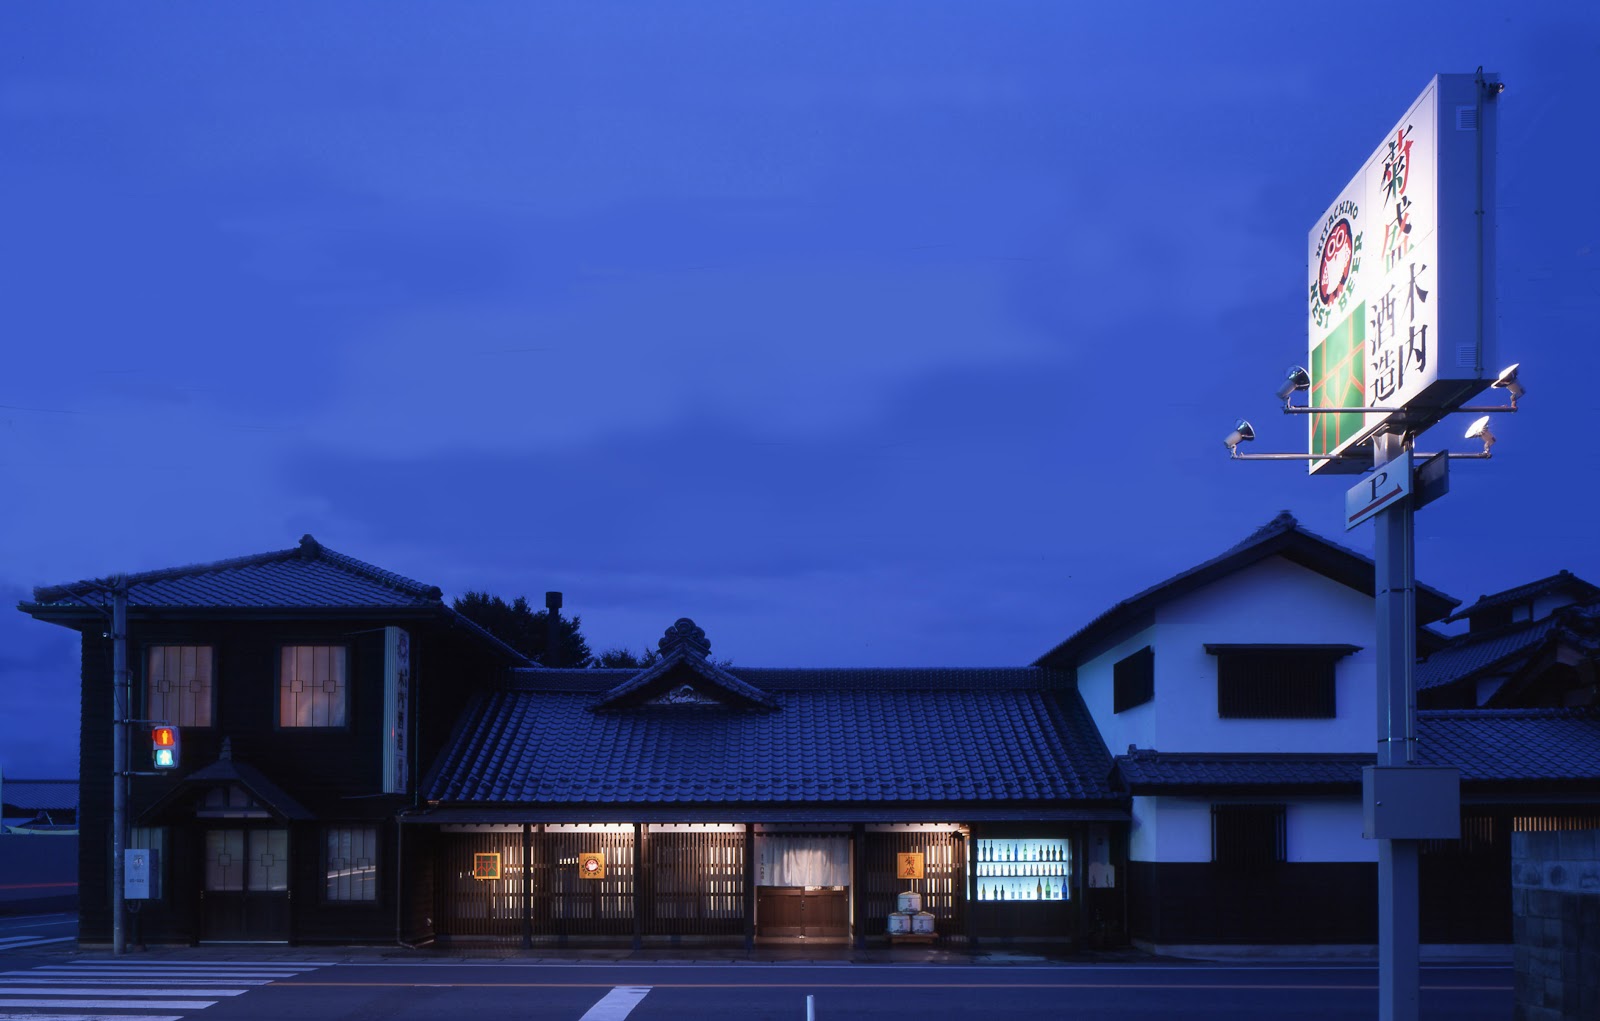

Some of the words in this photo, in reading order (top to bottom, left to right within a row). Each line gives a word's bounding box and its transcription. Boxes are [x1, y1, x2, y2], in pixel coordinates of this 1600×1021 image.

[1316, 200, 1358, 259] HITACHINO
[1311, 279, 1331, 329] NEST
[1338, 231, 1363, 313] BEER
[1398, 262, 1428, 390] 木内
[1370, 284, 1397, 407] 酒造
[1369, 472, 1388, 502] P
